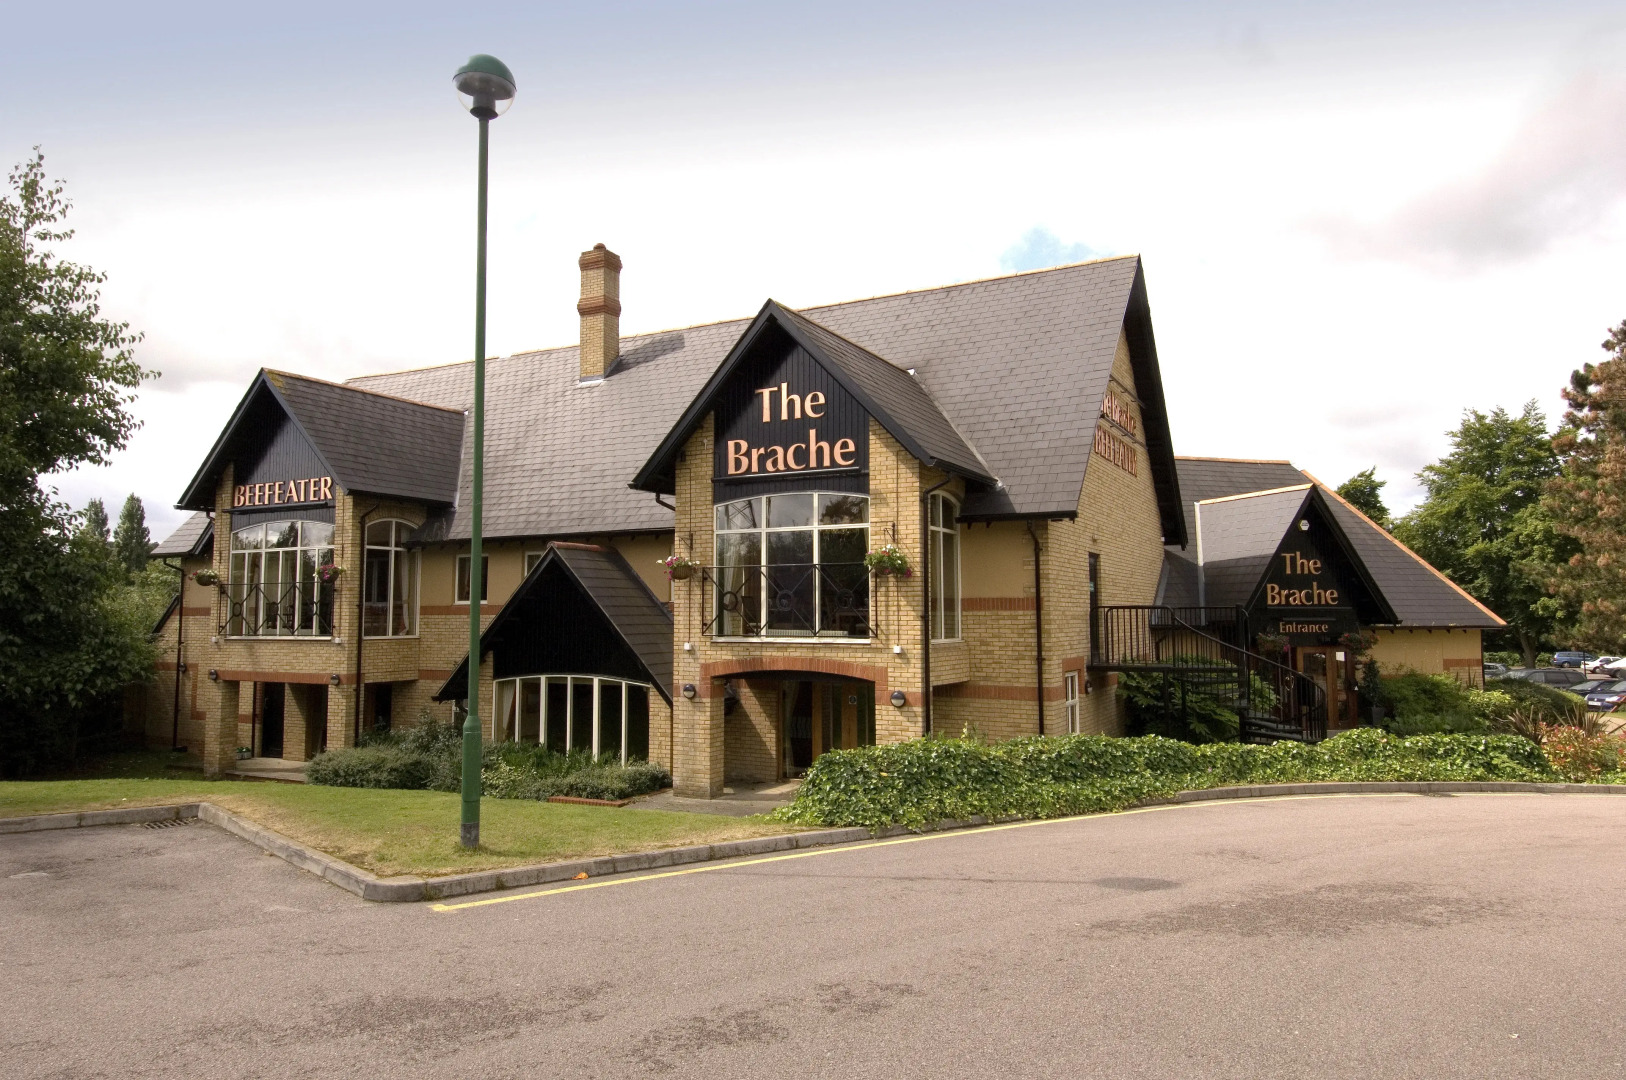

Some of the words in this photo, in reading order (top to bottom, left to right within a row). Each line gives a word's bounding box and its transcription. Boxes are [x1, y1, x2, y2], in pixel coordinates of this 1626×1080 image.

[754, 382, 826, 423] The
[727, 428, 856, 475] Brache
[233, 476, 333, 508] BEEFEATER
[1281, 551, 1322, 575] The
[1266, 581, 1339, 605] Brache
[1279, 621, 1329, 633] Entrance
